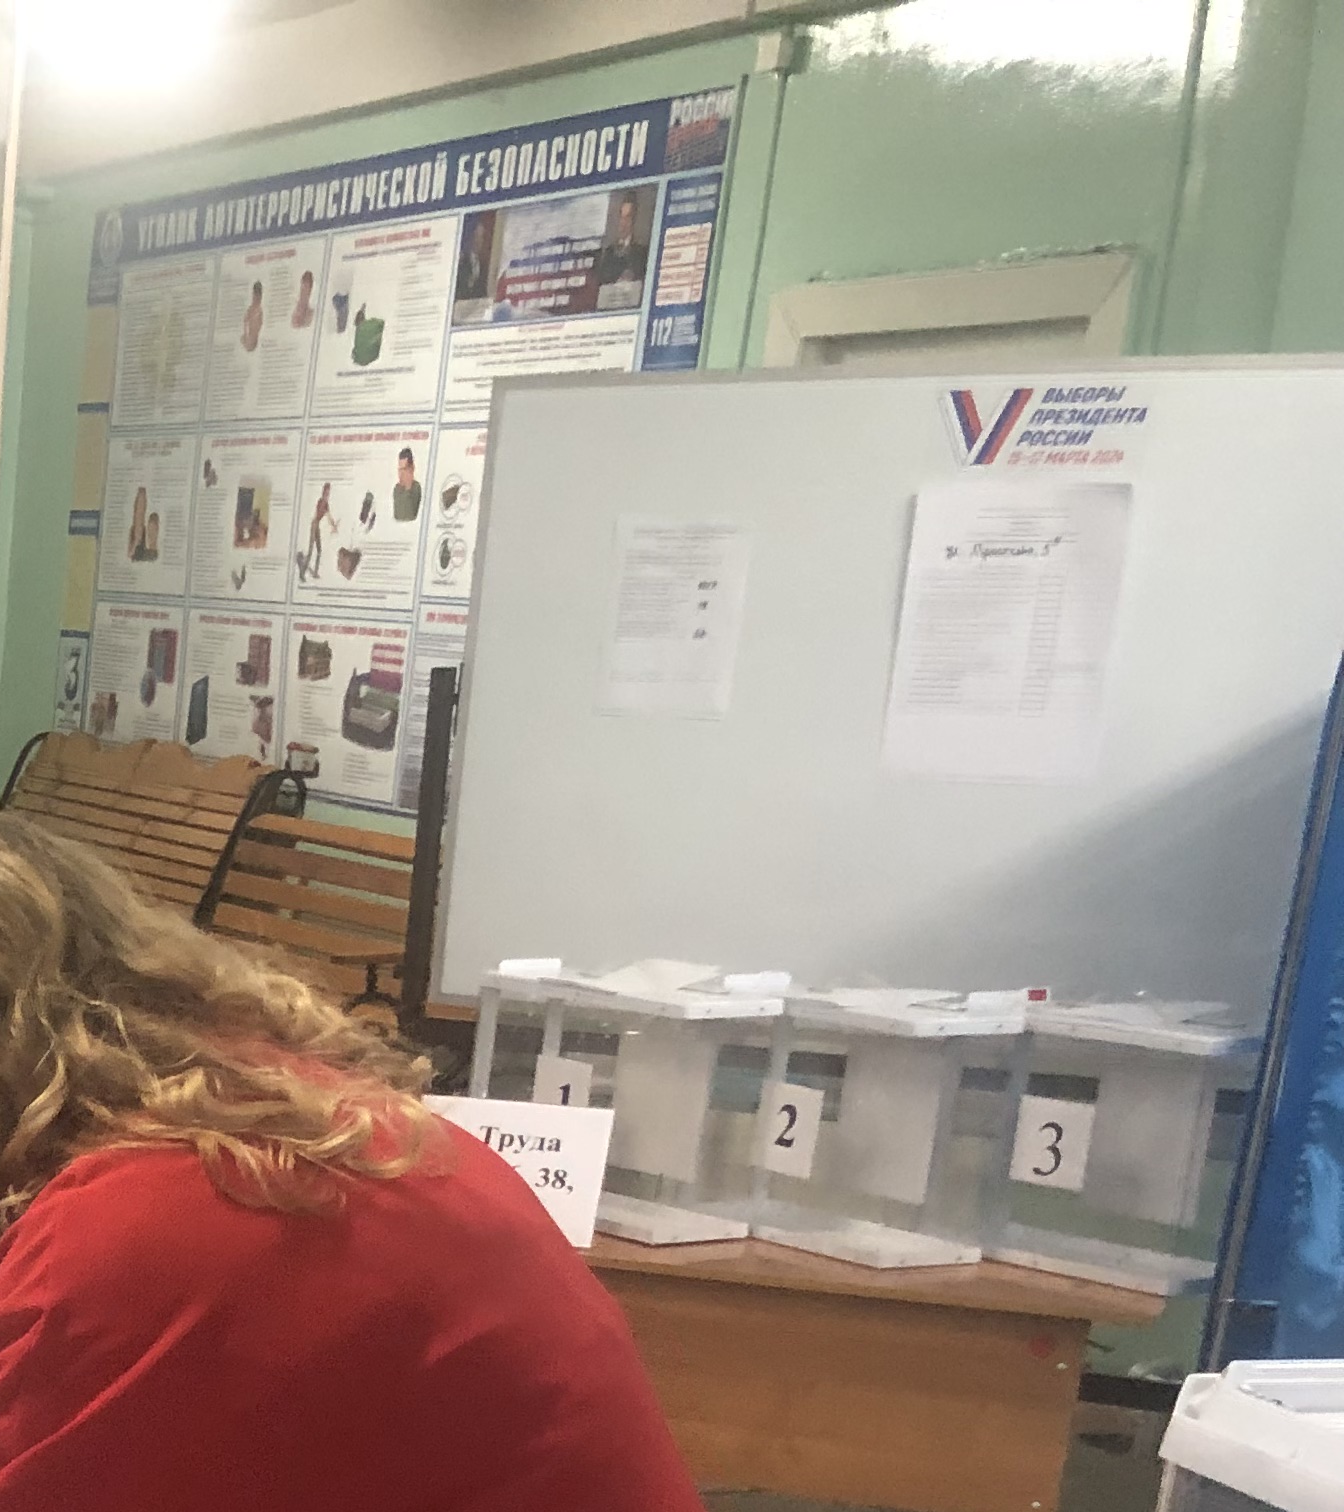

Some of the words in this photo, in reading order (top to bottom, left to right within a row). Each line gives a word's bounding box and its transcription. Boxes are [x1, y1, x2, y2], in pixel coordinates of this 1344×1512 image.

[455, 119, 650, 197] БЕЗОПАСНОСТИ
[1041, 385, 1127, 404] ВЫБОРЫ
[1028, 406, 1149, 427] ПРЕЗИДЕНТА
[1015, 429, 1095, 448] РОССИИ
[479, 1125, 561, 1154] Труда
[774, 1103, 798, 1149] 2
[1032, 1121, 1064, 1177] 3
[534, 1167, 574, 1194] 38,
